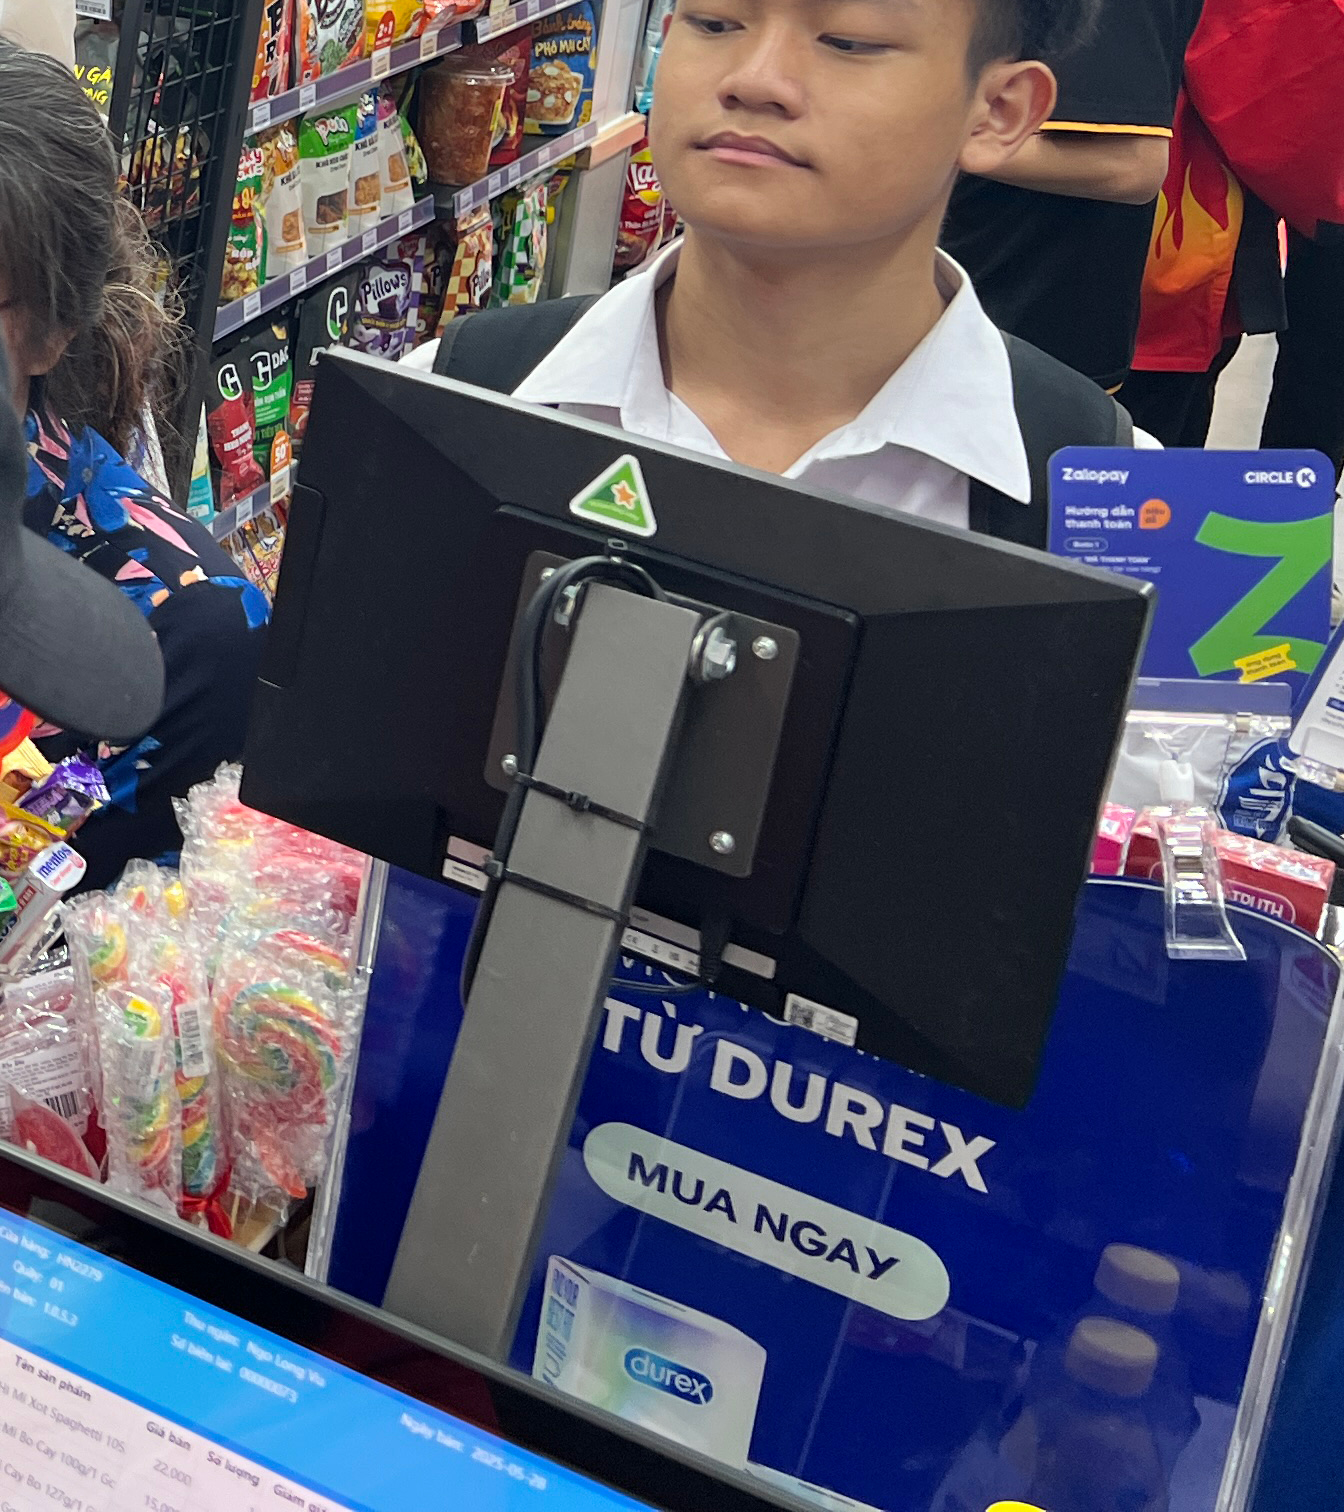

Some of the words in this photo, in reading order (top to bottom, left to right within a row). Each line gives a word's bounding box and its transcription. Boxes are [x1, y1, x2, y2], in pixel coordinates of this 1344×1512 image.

[361, 272, 407, 305] Pillows
[1062, 467, 1130, 485] Zalopay
[1245, 471, 1293, 484] CIRCLE
[1296, 467, 1316, 488] K
[603, 997, 703, 1075] TỪ
[710, 1038, 997, 1195] DUREX
[625, 1151, 738, 1226] MUA
[754, 1202, 900, 1283] NGAY
[630, 1351, 711, 1403] durex
